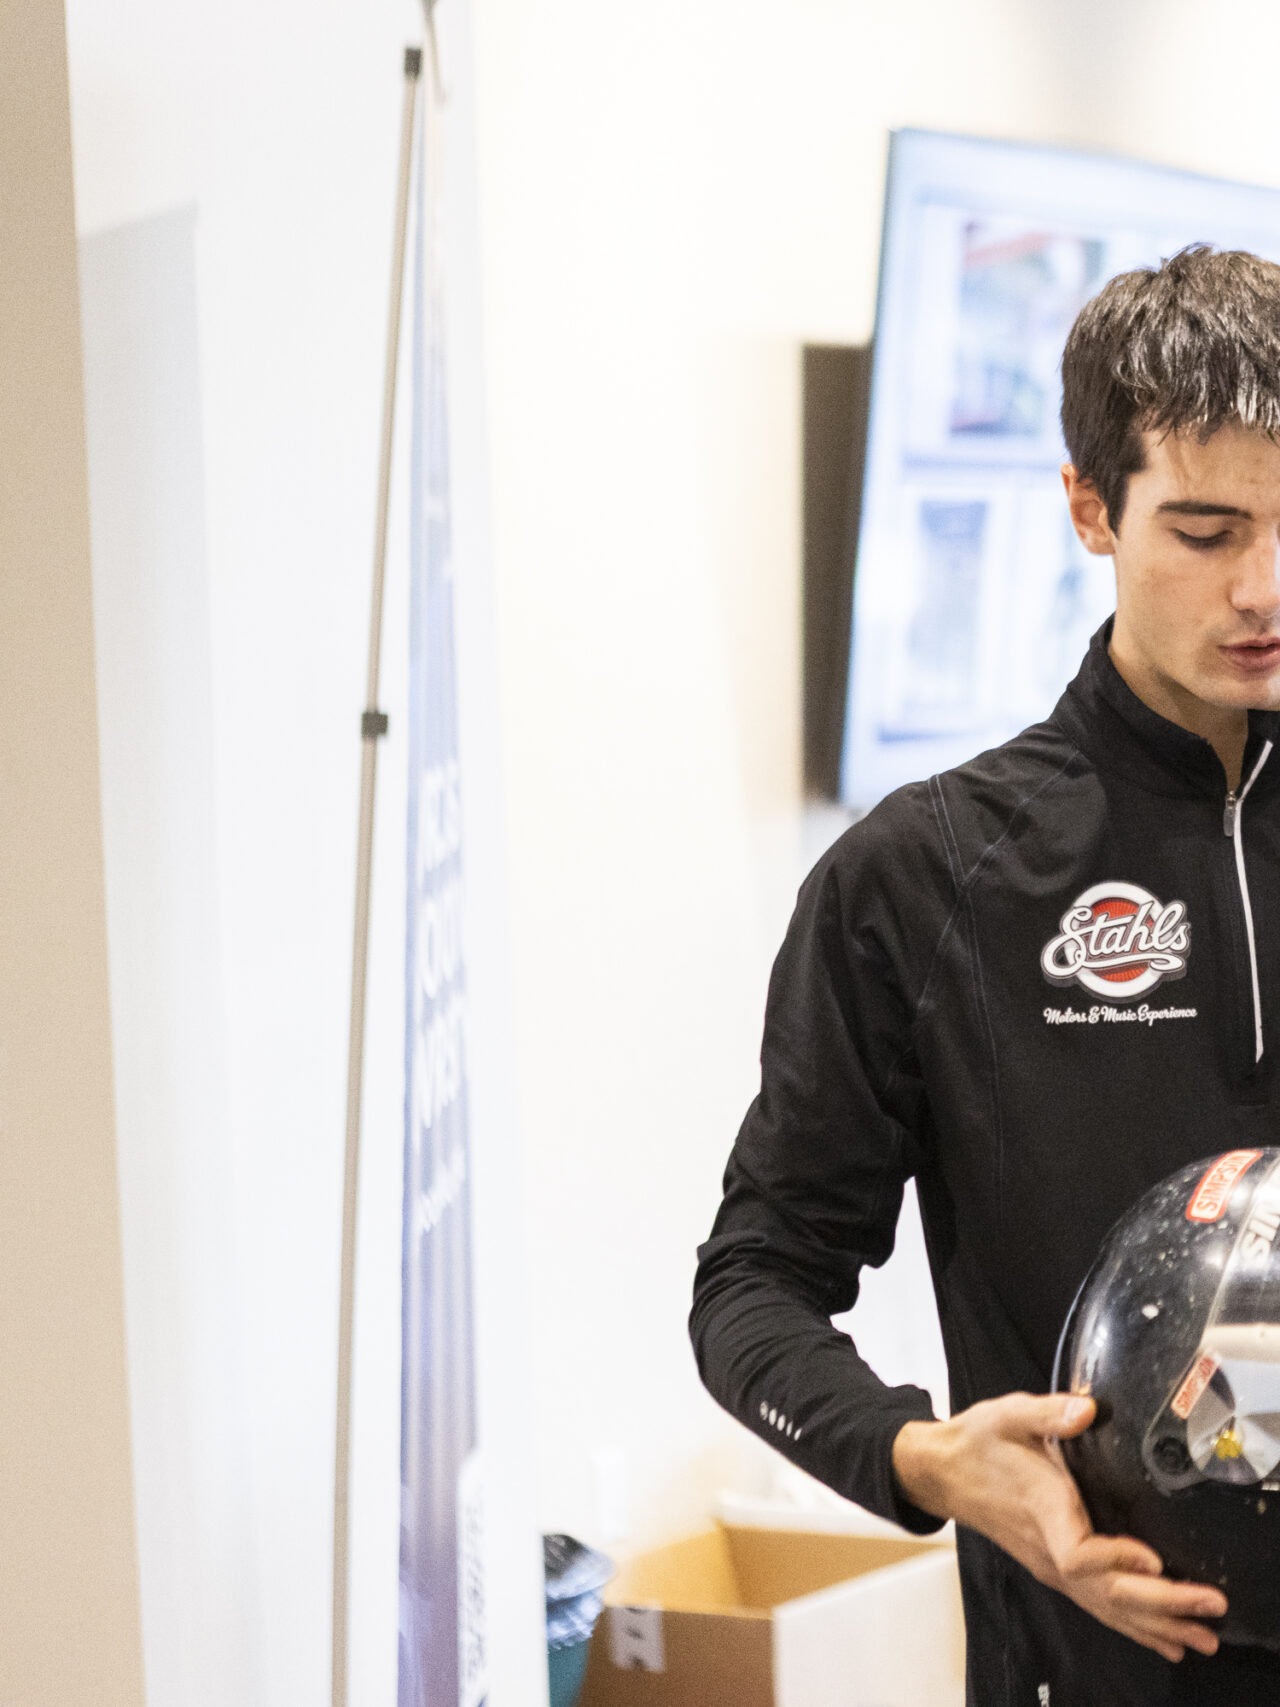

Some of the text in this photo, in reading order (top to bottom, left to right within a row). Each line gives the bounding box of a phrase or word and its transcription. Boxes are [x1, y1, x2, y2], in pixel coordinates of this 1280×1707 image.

[1041, 900, 1190, 978] Stahls
[1043, 1003, 1198, 1027] Motors & Music Experience
[1194, 1152, 1255, 1213] SIMPSON
